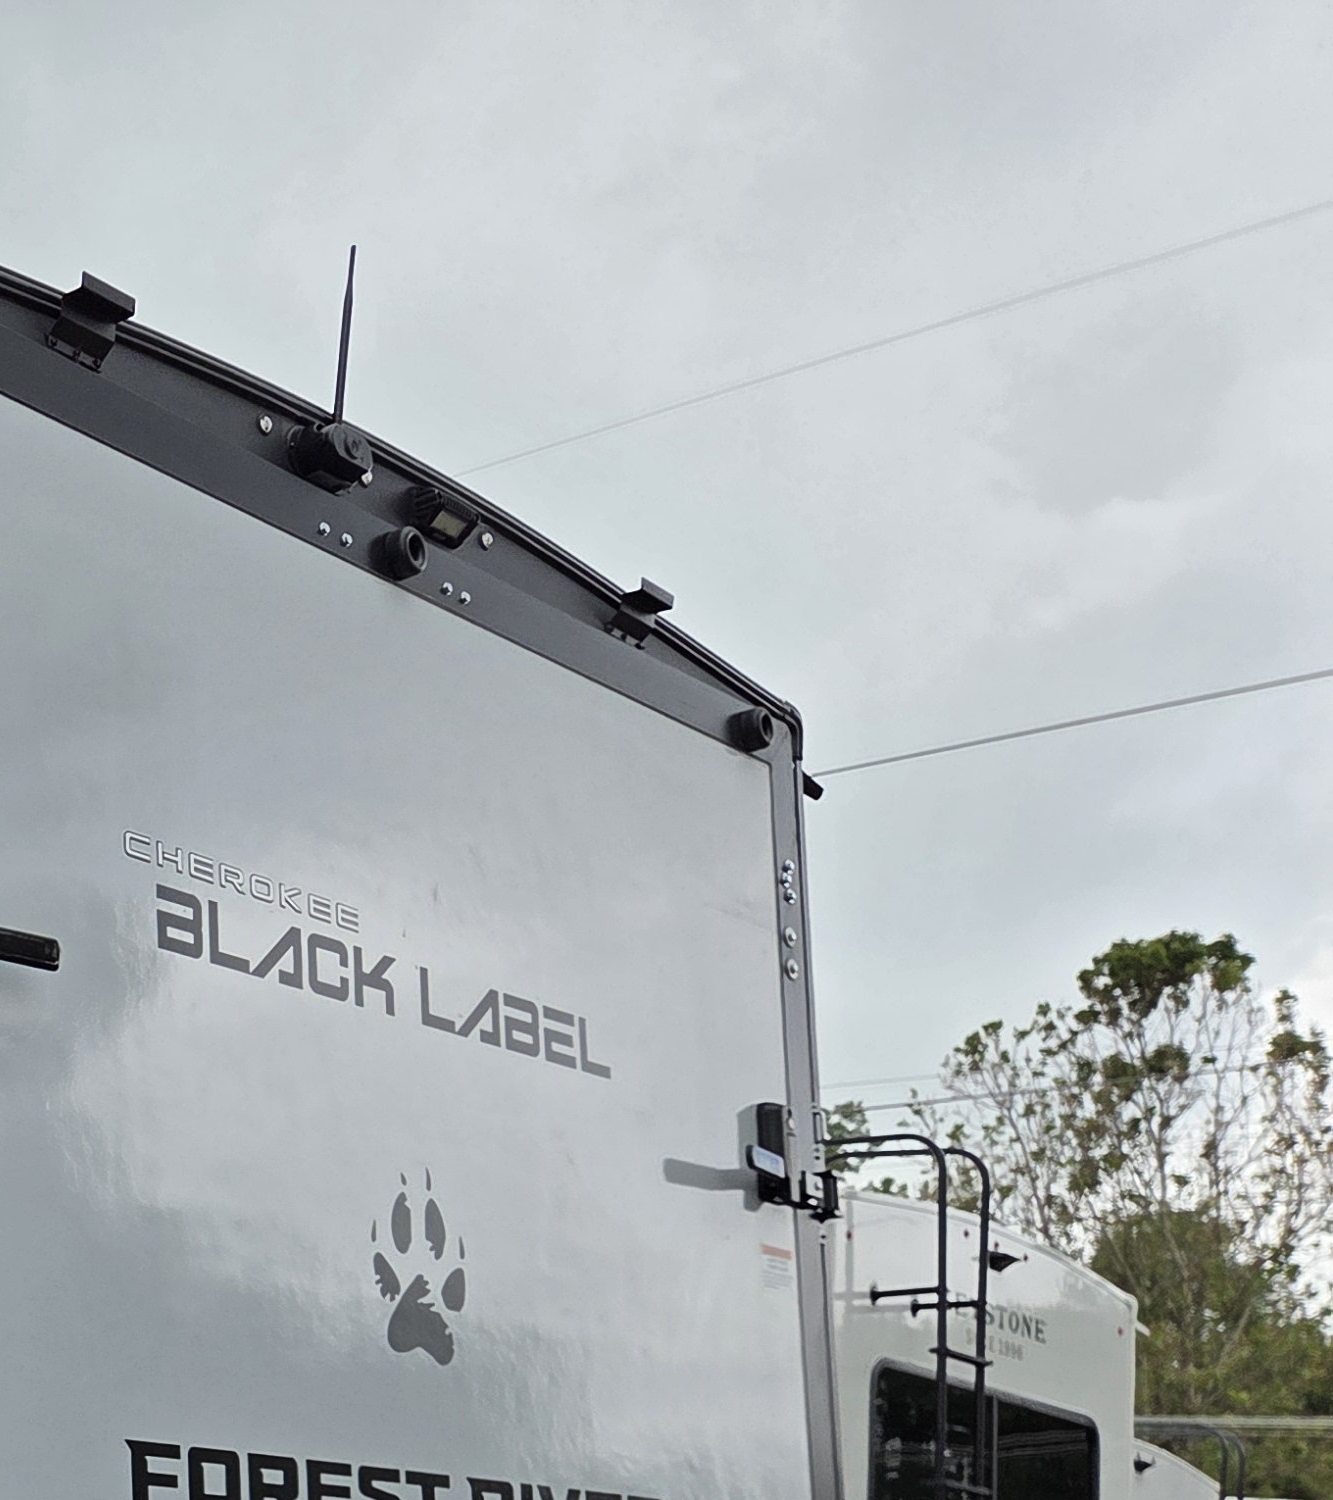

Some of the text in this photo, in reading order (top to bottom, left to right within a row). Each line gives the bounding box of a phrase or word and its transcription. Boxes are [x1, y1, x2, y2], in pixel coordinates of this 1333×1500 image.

[122, 829, 360, 934] CHEROKEE
[155, 883, 612, 1079] BLACK LABEL
